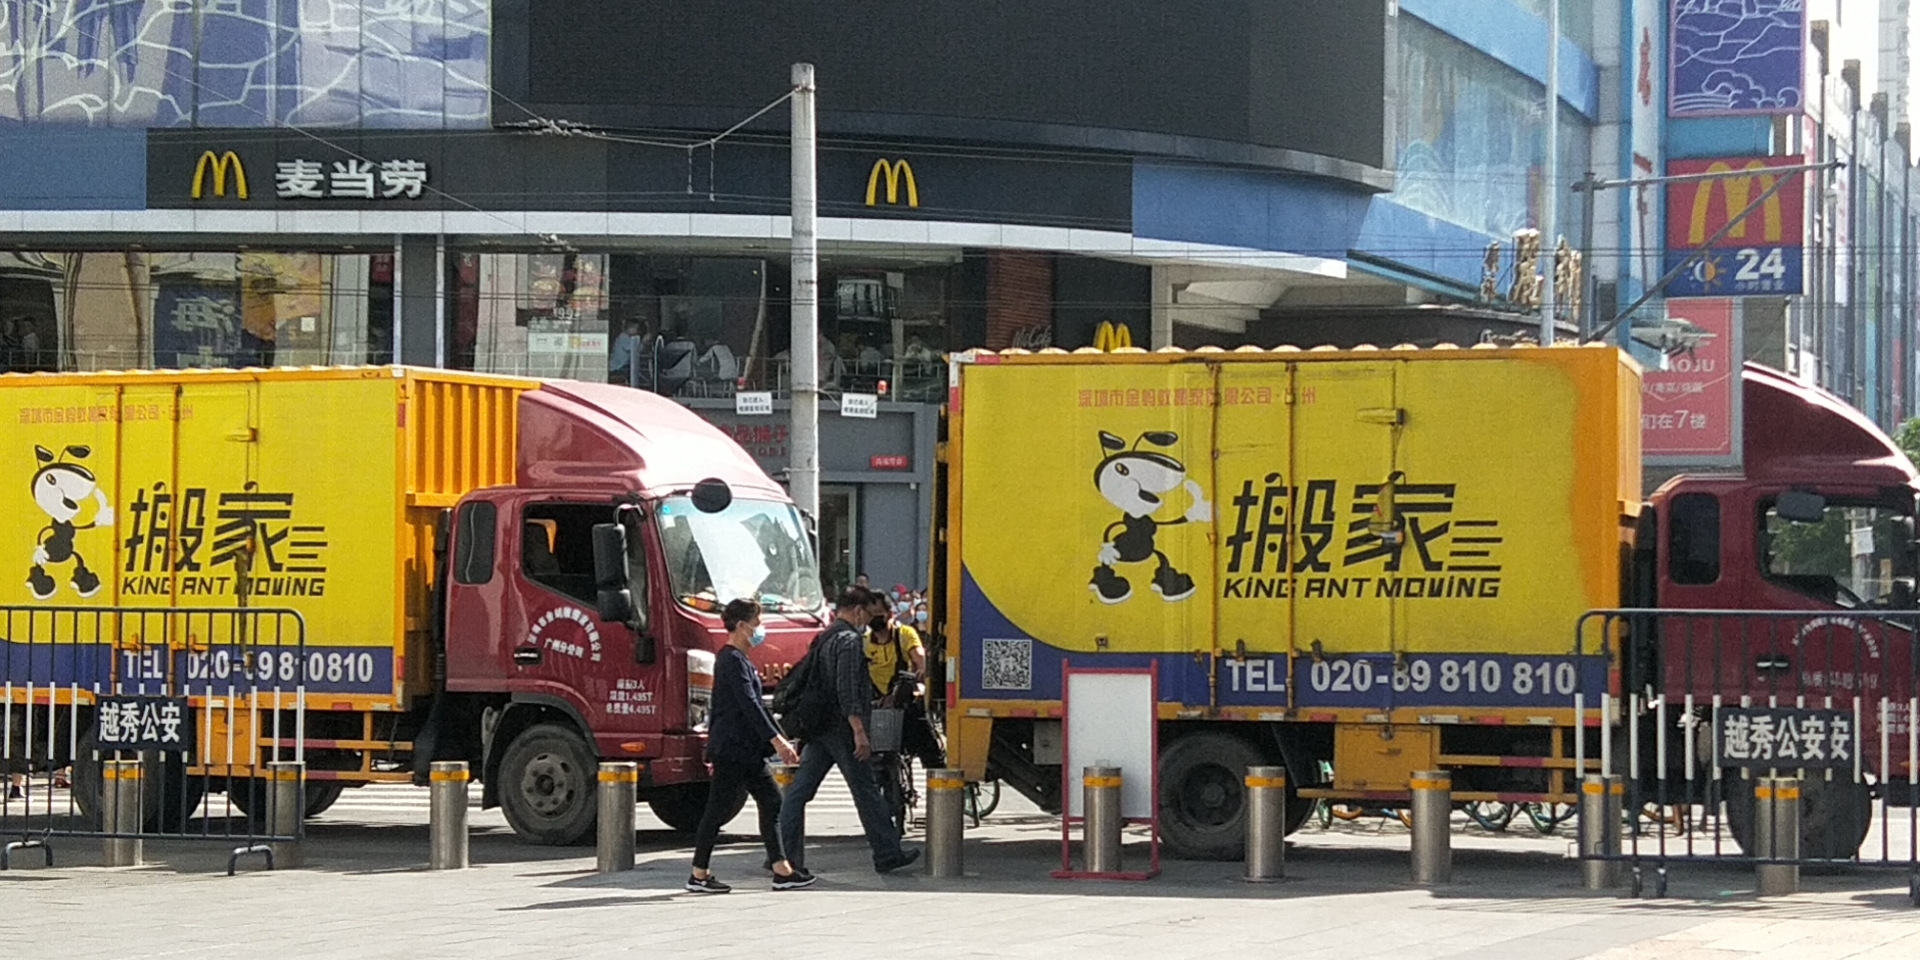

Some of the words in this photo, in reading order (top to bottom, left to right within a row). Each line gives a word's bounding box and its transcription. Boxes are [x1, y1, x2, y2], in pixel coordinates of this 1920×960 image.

[275, 159, 427, 199] 麦当劳
[1734, 247, 1787, 281] 24
[125, 481, 294, 572] 搬家
[1225, 472, 1457, 573] 搬家
[181, 577, 231, 596] ANT
[1304, 577, 1372, 599] ANT
[123, 650, 164, 680] TEL
[1226, 659, 1286, 693] TEL
[98, 701, 182, 743] 越秀公安
